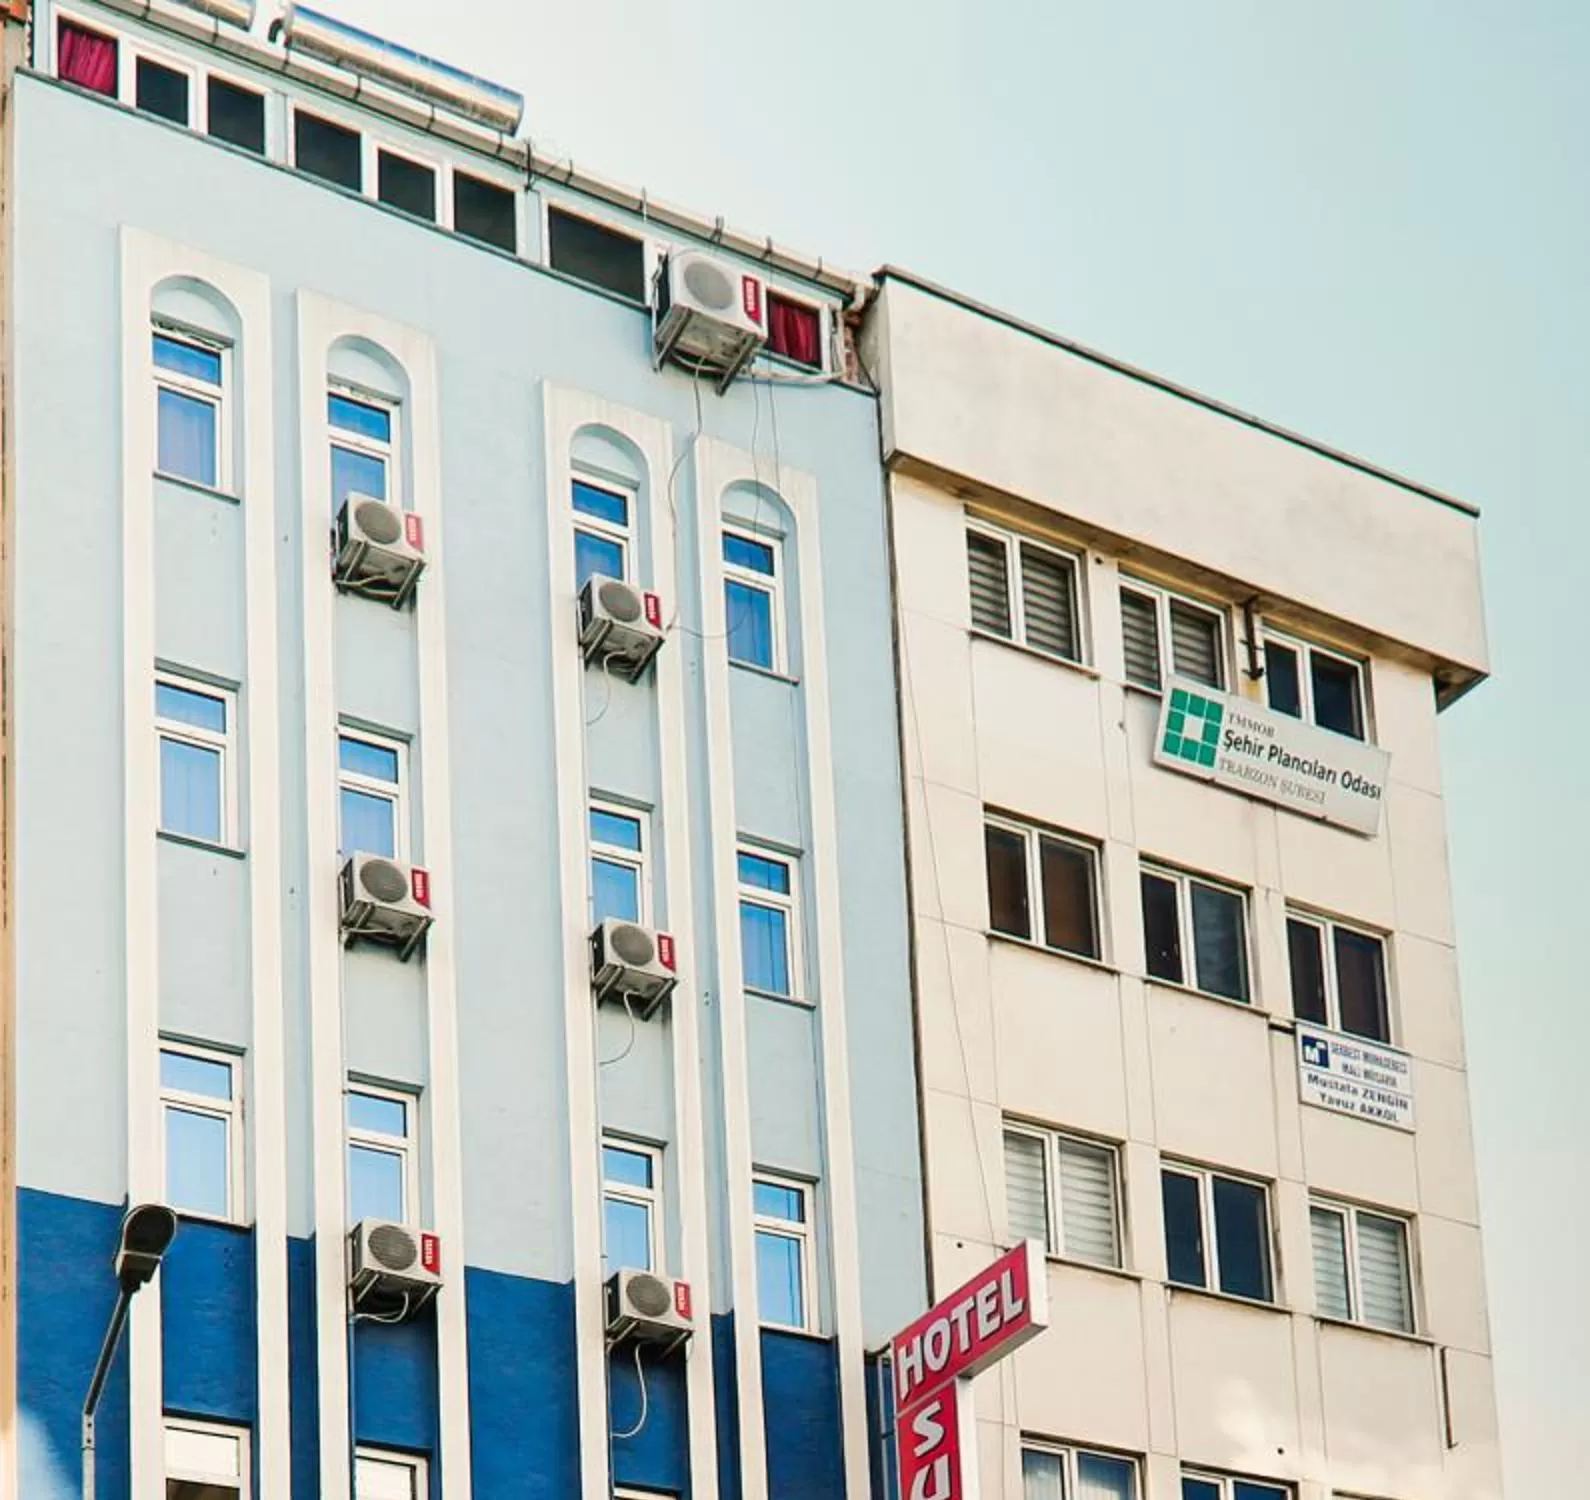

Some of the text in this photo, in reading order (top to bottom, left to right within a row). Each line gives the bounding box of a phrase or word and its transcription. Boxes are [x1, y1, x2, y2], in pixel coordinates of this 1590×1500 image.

[1224, 729, 1382, 801] Şehir Plancıları Odası
[899, 1269, 1026, 1400] HOTEL
